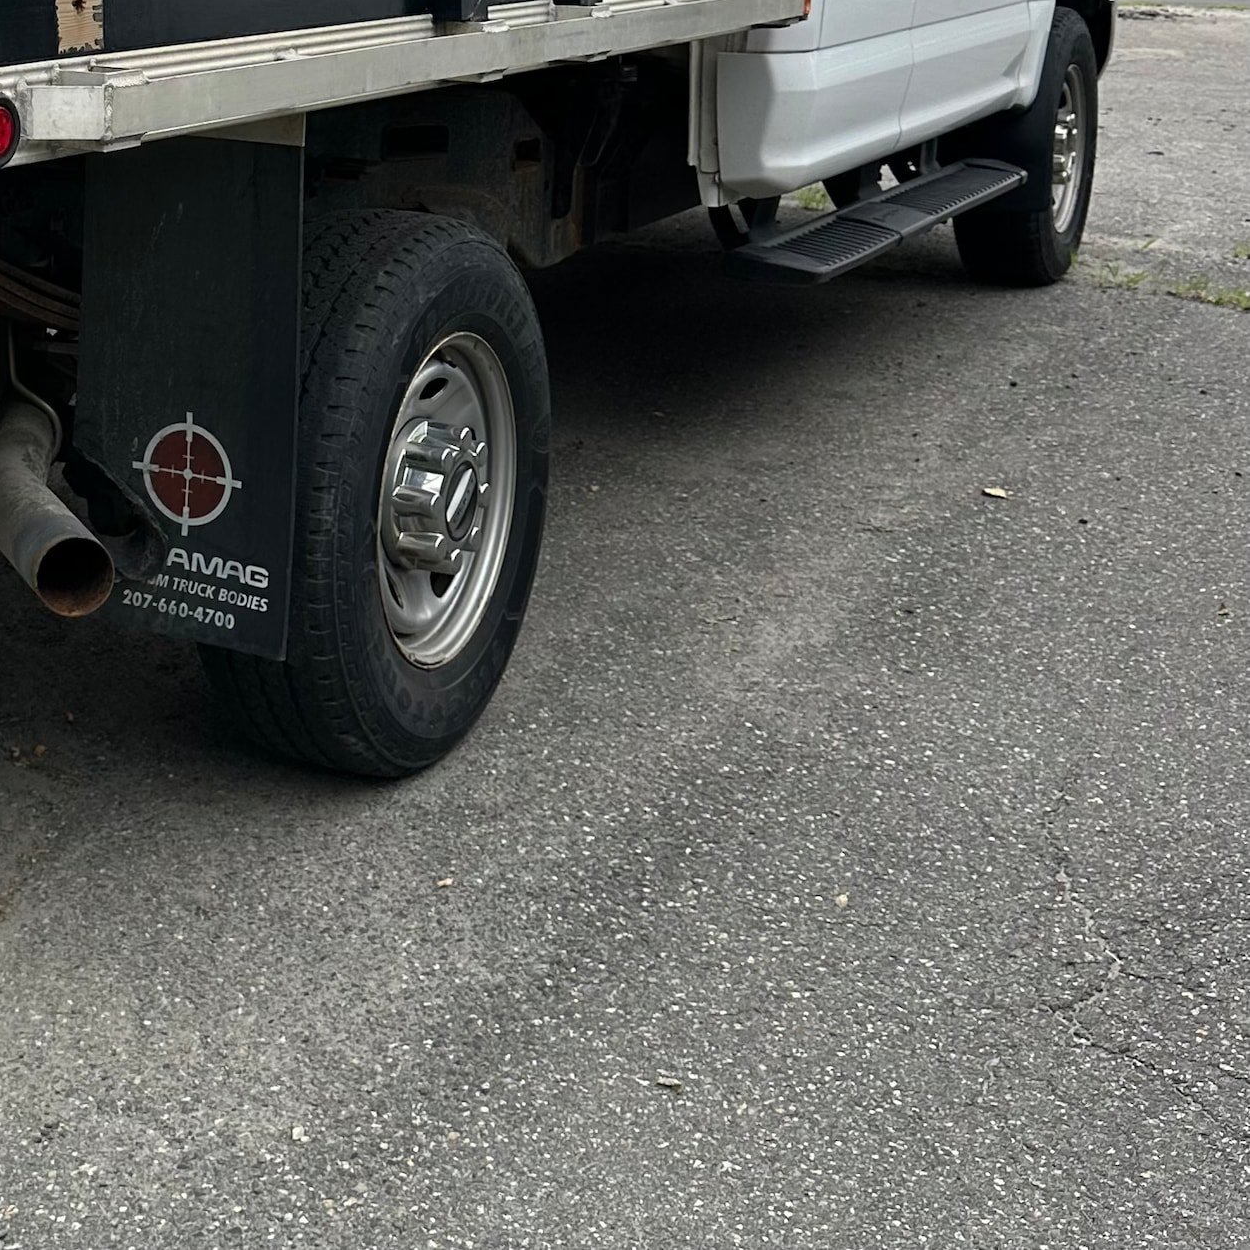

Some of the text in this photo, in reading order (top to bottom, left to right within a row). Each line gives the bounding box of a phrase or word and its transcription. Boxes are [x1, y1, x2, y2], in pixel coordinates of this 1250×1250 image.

[166, 548, 269, 588] AMAG
[122, 589, 236, 629] 207-660-4700
[172, 577, 215, 599] TRUCK
[218, 589, 269, 612] BODIES
